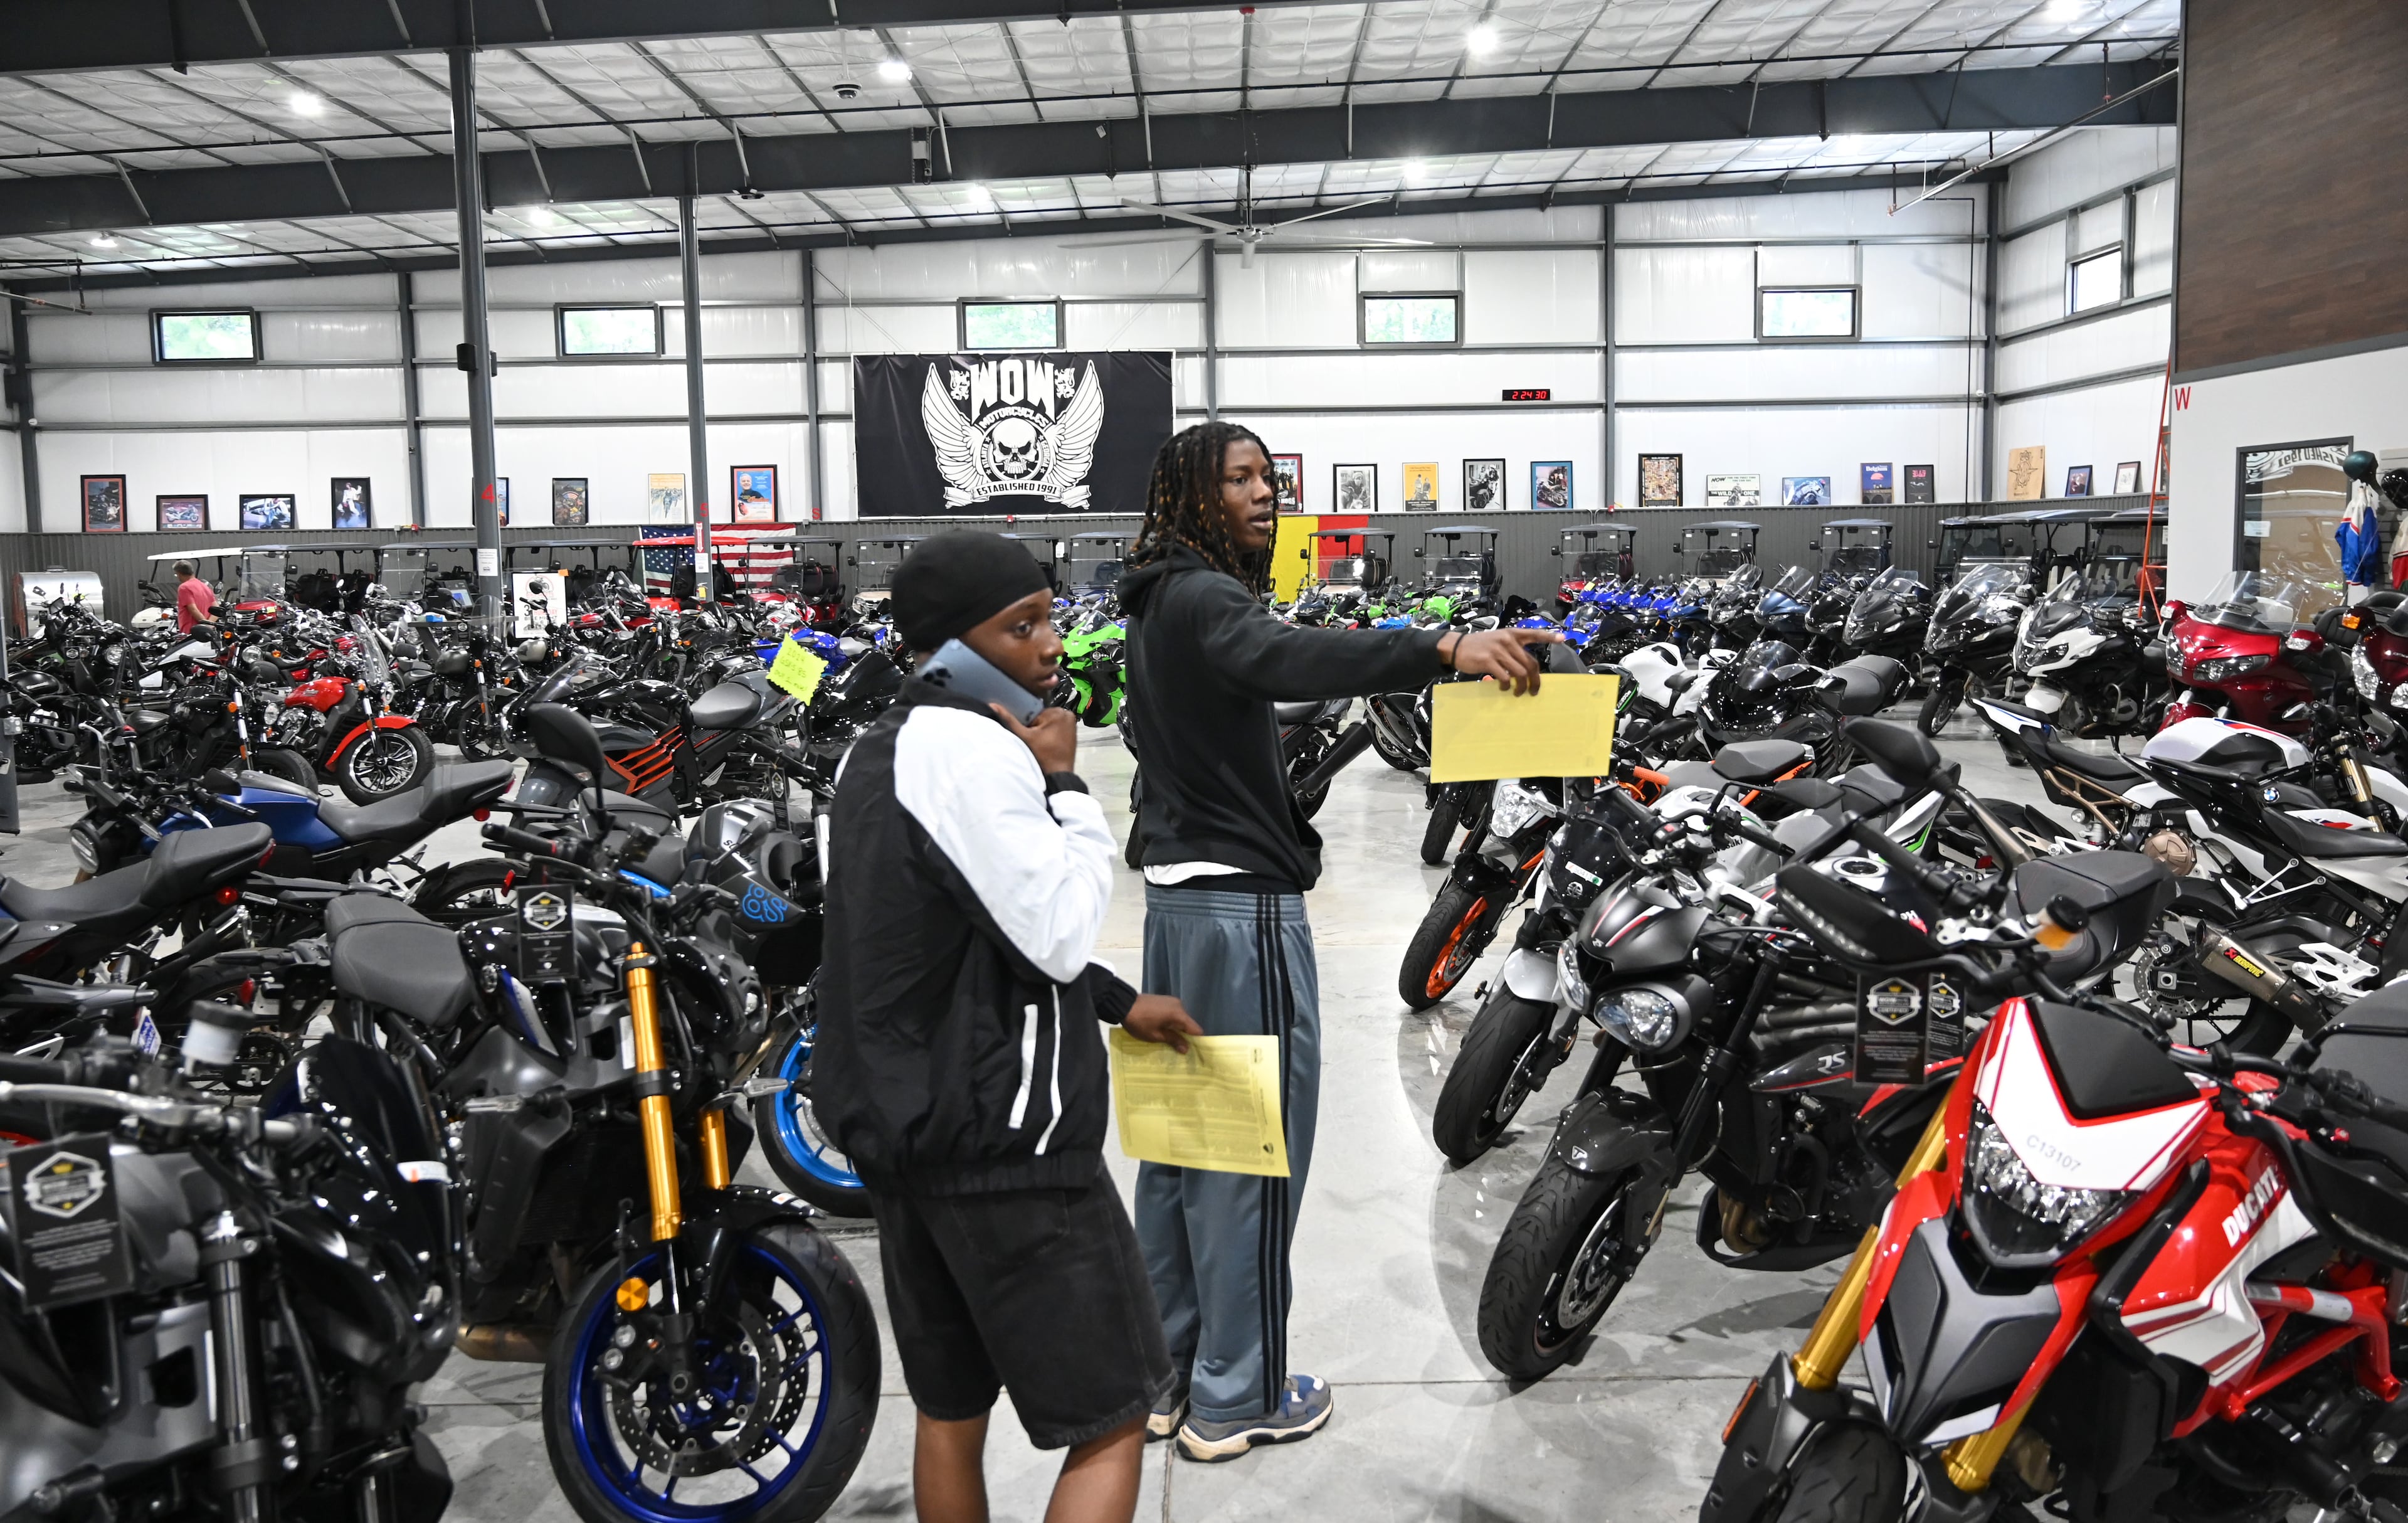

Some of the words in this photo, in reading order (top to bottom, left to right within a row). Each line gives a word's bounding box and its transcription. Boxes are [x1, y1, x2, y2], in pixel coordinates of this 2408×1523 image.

[969, 359, 1056, 425] WOW
[2175, 386, 2192, 411] W
[978, 406, 1050, 429] MOTORCYCLES
[481, 483, 495, 504] 4
[976, 482, 1035, 496] ESTABLISHED
[1037, 482, 1057, 494] 1991
[1817, 1050, 1846, 1075] RS
[2026, 1134, 2082, 1172] C13107
[2221, 1165, 2279, 1248] DUCATI
